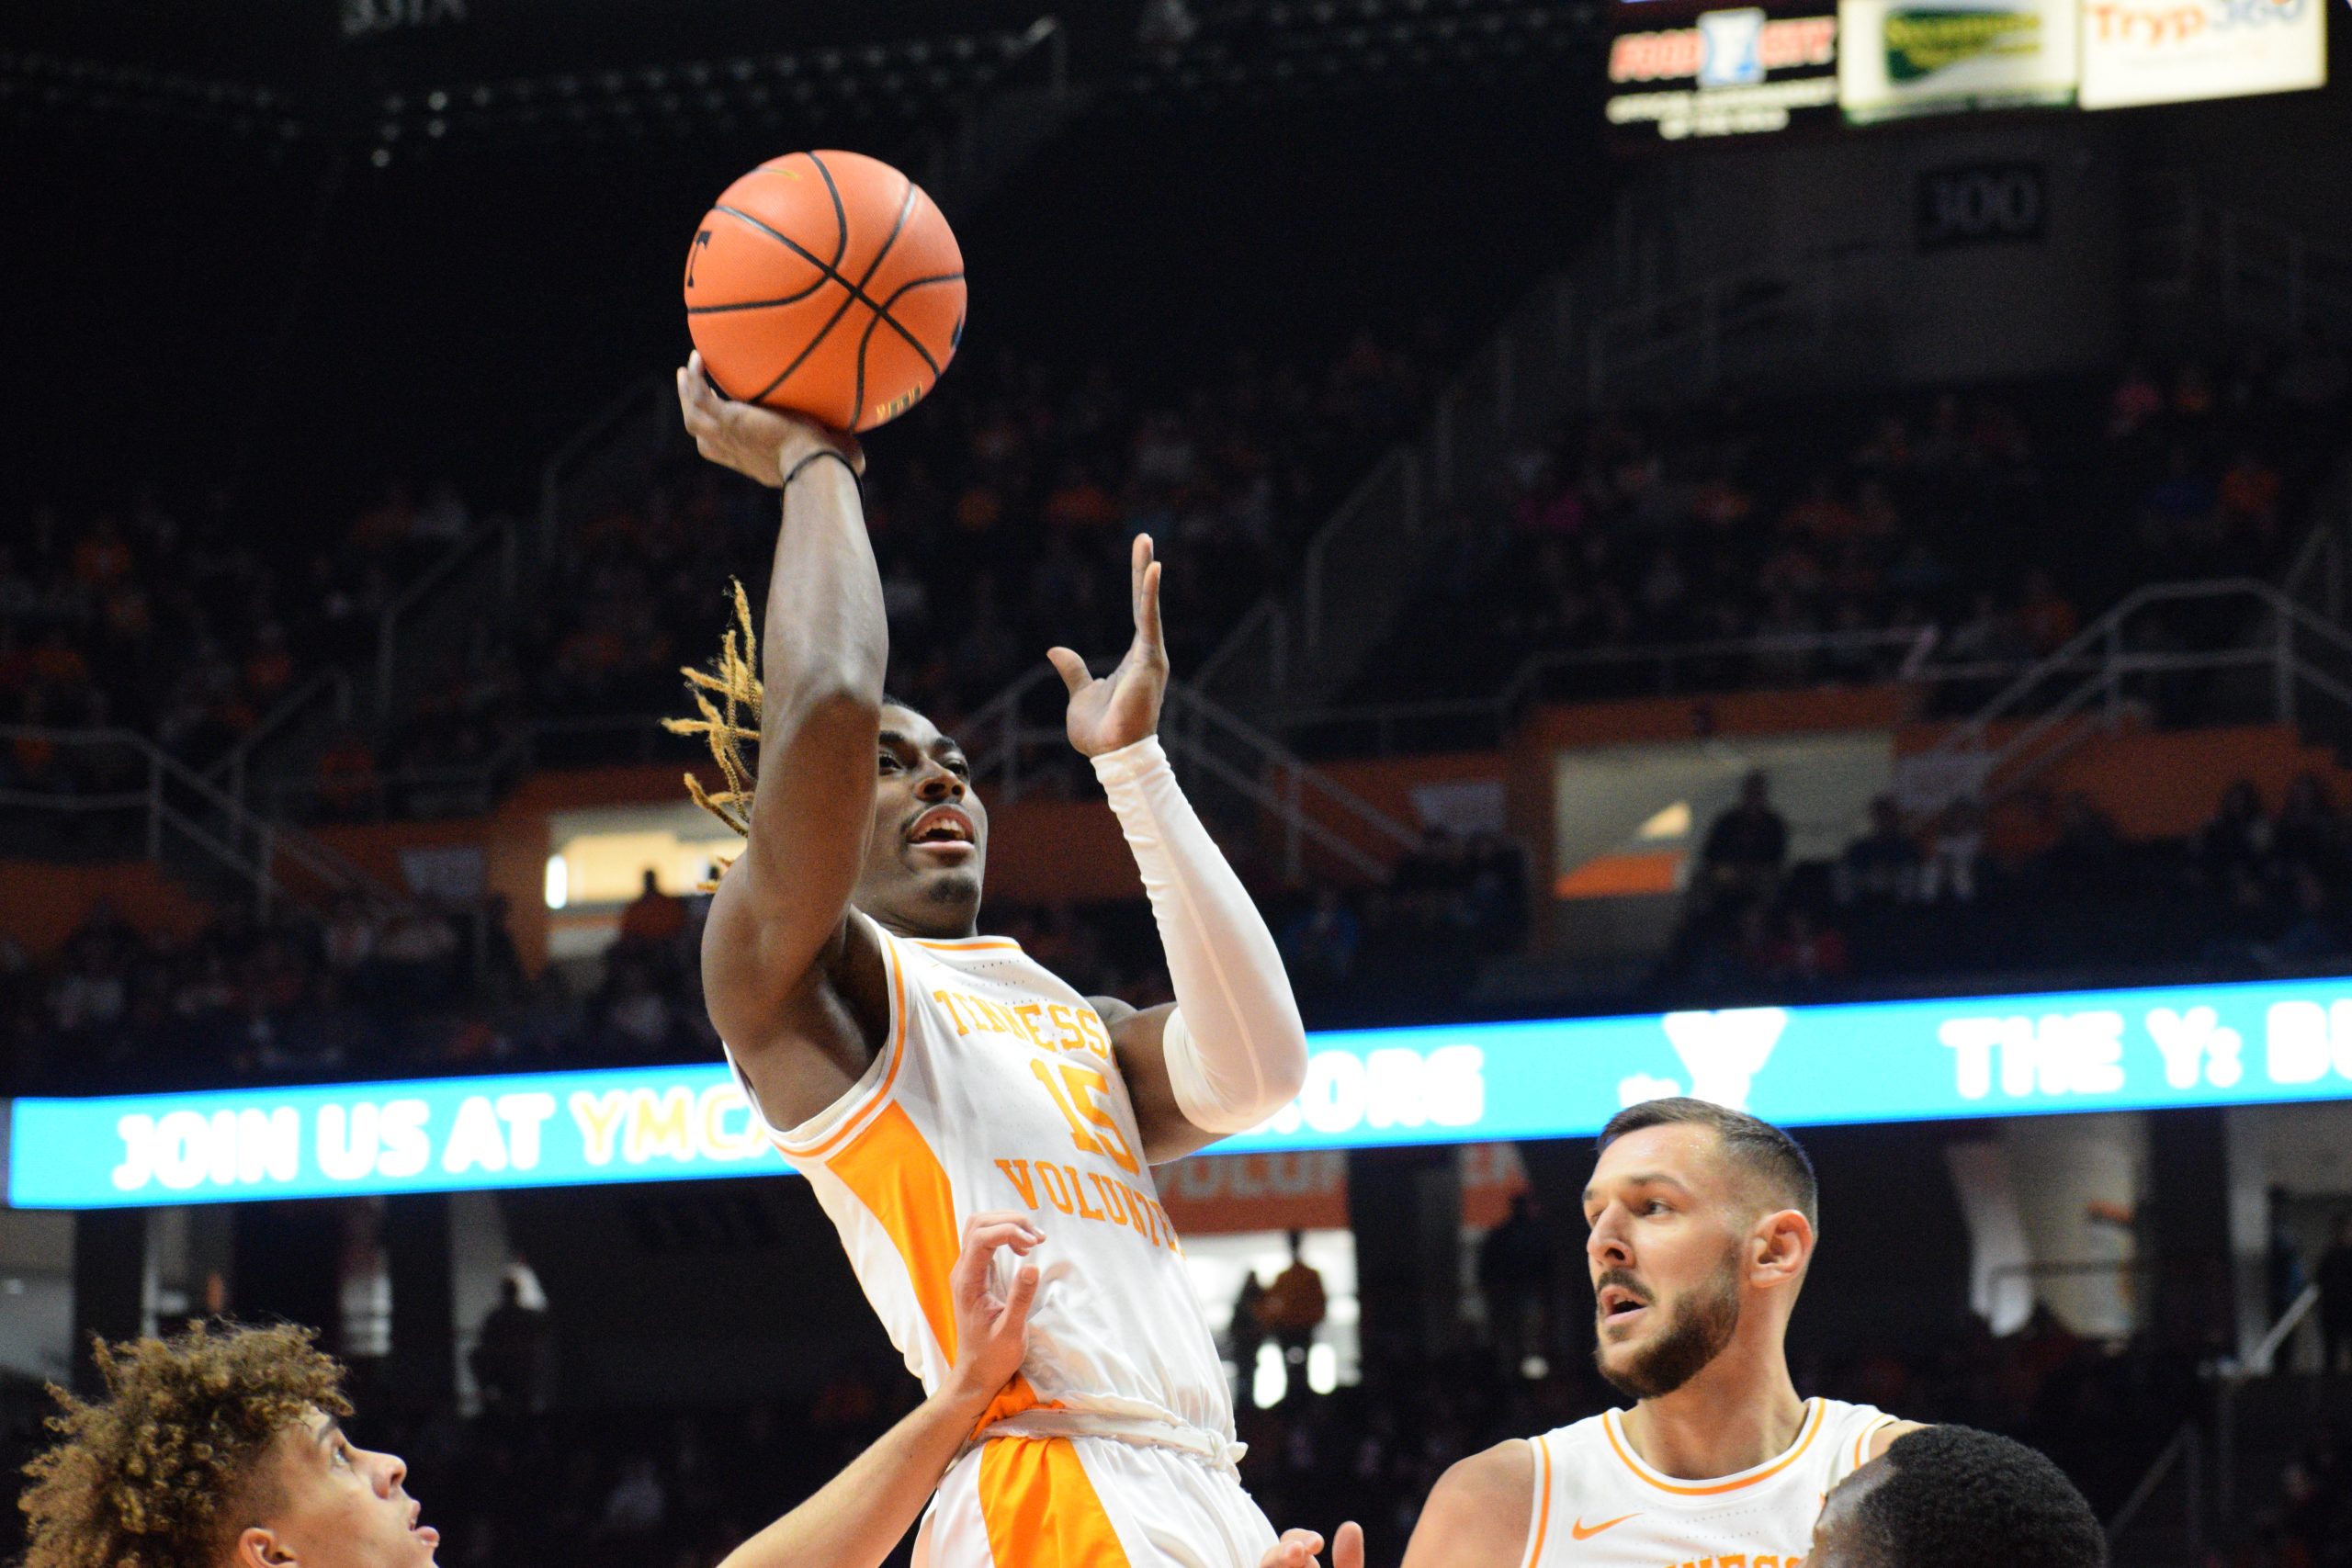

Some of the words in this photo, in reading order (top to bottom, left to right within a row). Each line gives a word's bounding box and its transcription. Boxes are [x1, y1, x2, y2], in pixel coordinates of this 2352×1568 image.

[1938, 1010, 2125, 1099] THE
[111, 1105, 300, 1191] JOIN
[316, 1099, 431, 1180] US
[441, 1092, 557, 1174] AT
[1029, 1057, 1140, 1177] 15
